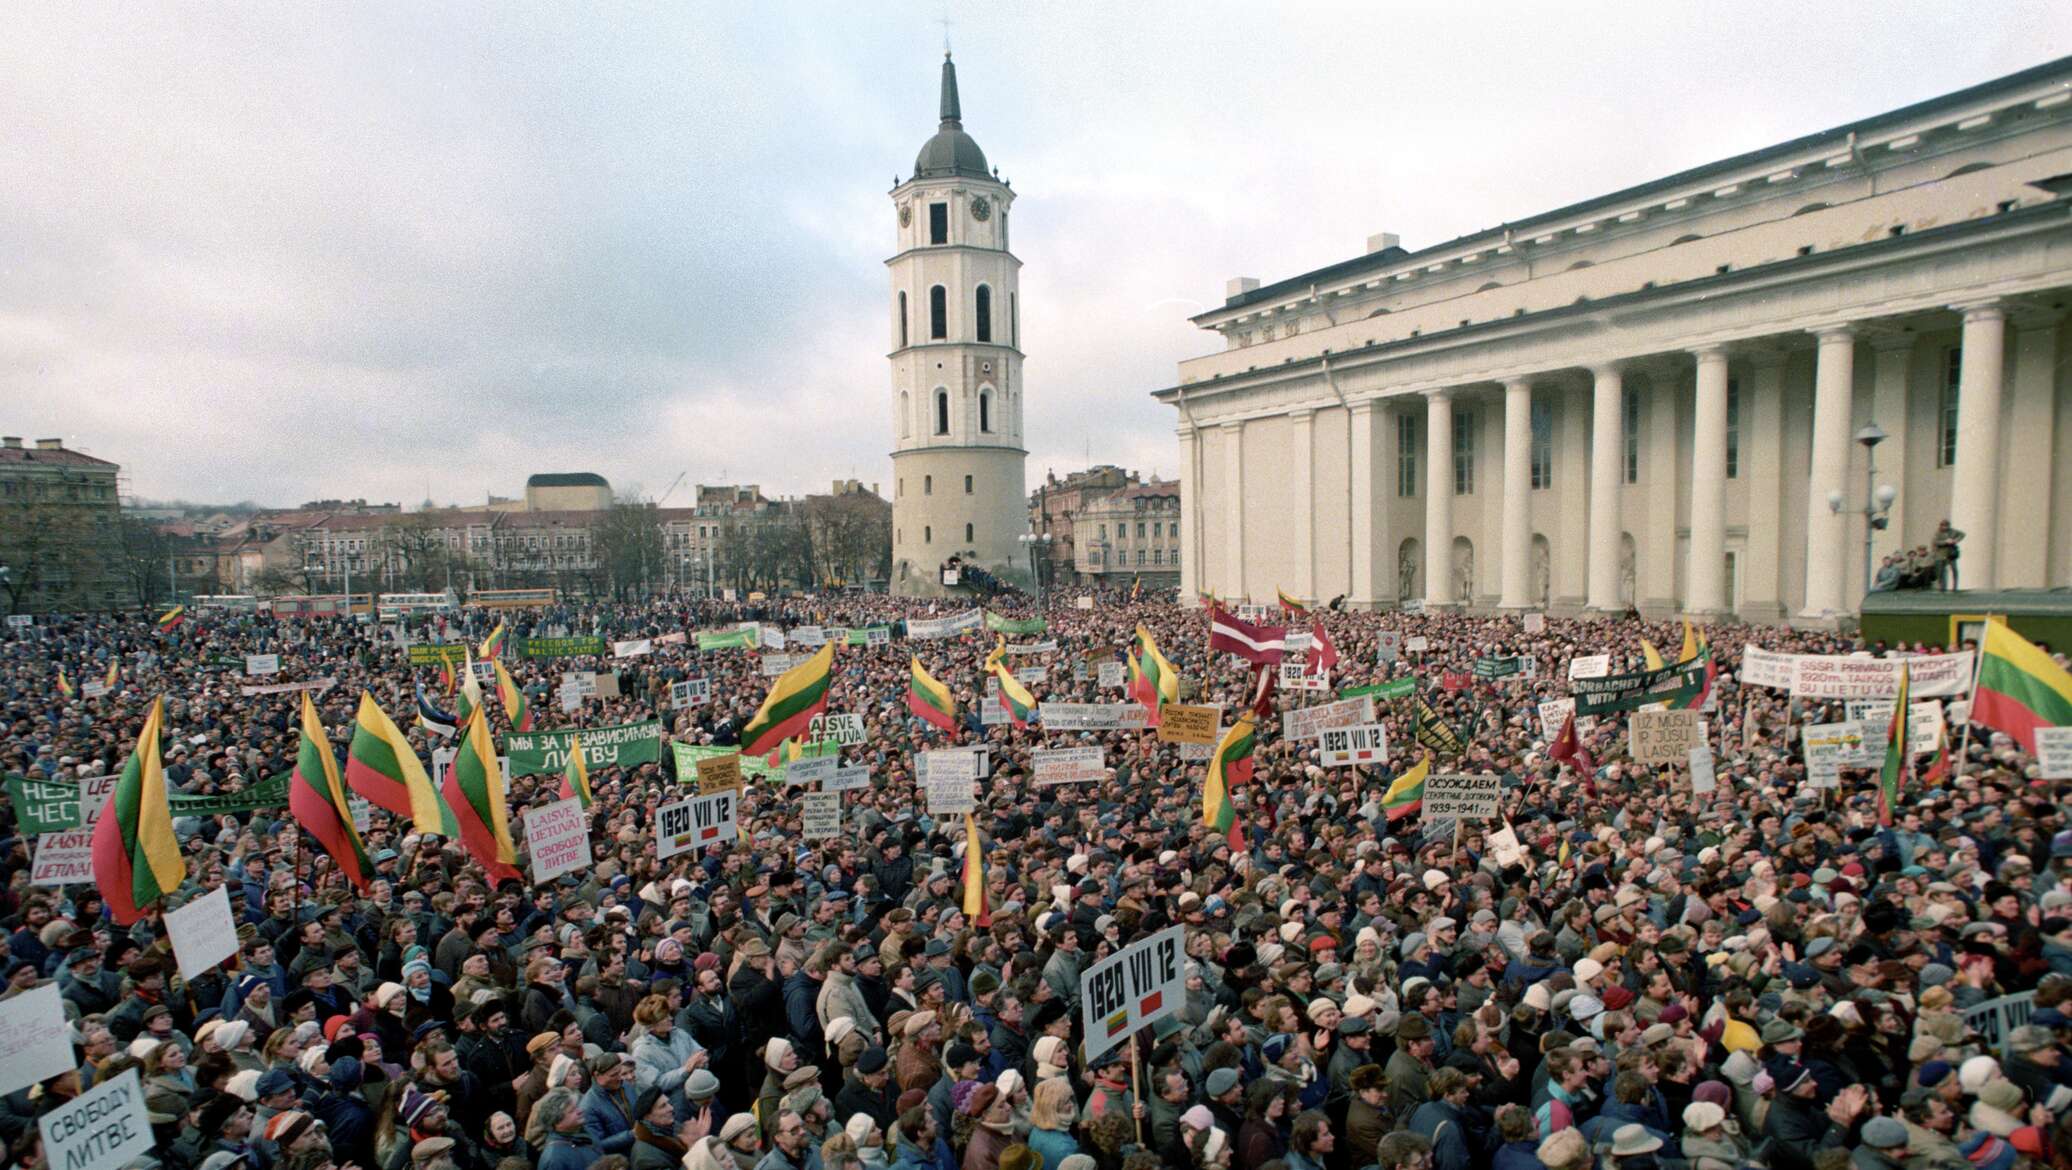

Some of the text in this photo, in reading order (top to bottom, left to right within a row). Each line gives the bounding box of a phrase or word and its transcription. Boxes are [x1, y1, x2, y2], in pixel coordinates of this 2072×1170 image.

[1586, 693, 1617, 706] WITH
[509, 736, 533, 750] МЫ
[541, 735, 559, 750] ЗА
[1323, 728, 1380, 752] 1920 VII 12
[542, 745, 618, 769] ЛИТВУ
[1428, 779, 1497, 790] ОСУЖДАЕМ
[661, 796, 730, 839] 1920 VII 12
[1429, 802, 1480, 814] 1939-1941
[536, 832, 585, 860] СВОБОДУ
[543, 850, 577, 871] ЛИТВЕ
[1089, 937, 1176, 1025] 1920 VII 12
[50, 1081, 132, 1144] СВОБОДУ
[66, 1113, 137, 1170] ЛИТВЕ
